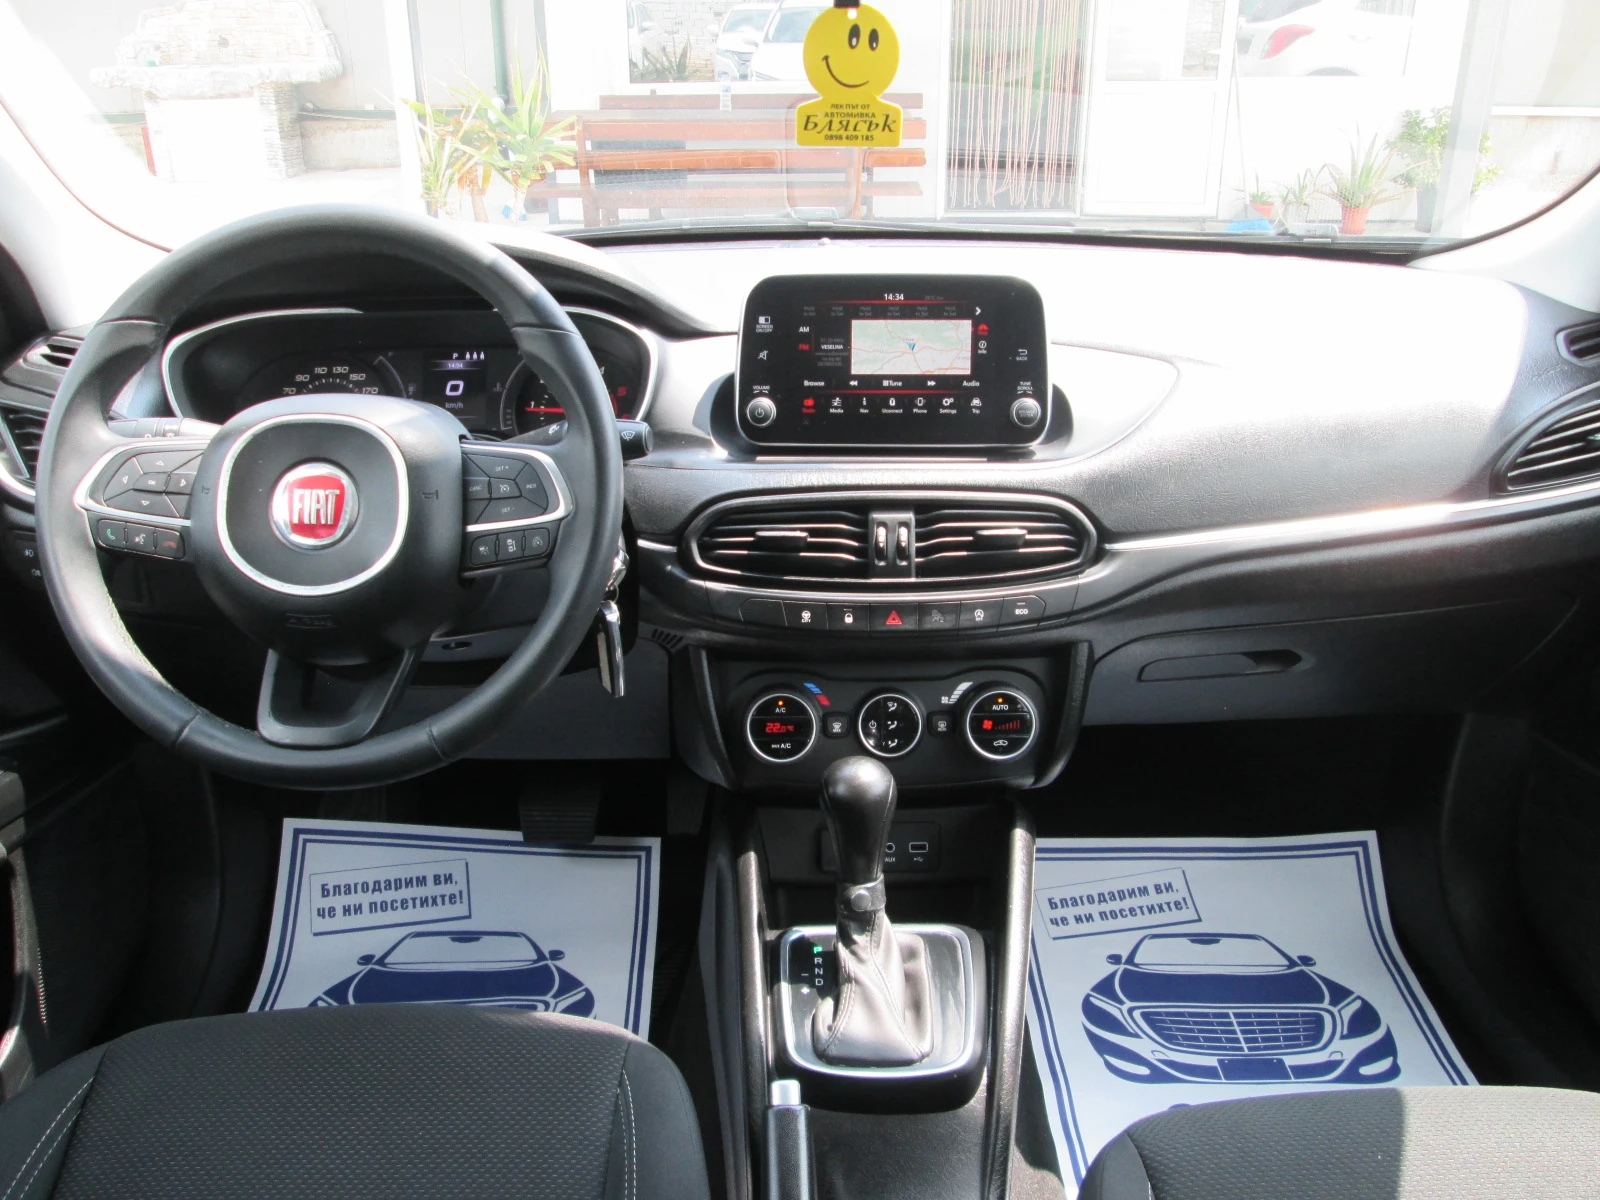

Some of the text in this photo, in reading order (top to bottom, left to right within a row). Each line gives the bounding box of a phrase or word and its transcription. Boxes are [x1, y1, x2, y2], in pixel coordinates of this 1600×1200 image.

[445, 380, 464, 396] 0
[292, 488, 340, 525] FIAT
[321, 875, 427, 898] Благодарим
[317, 890, 464, 920] че ни посетихте!
[1048, 885, 1150, 910] Благодарим
[1049, 897, 1190, 928] че ни посетихте!
[814, 946, 822, 954] P
[814, 957, 823, 965] R
[815, 968, 823, 976] N
[815, 978, 824, 986] D
